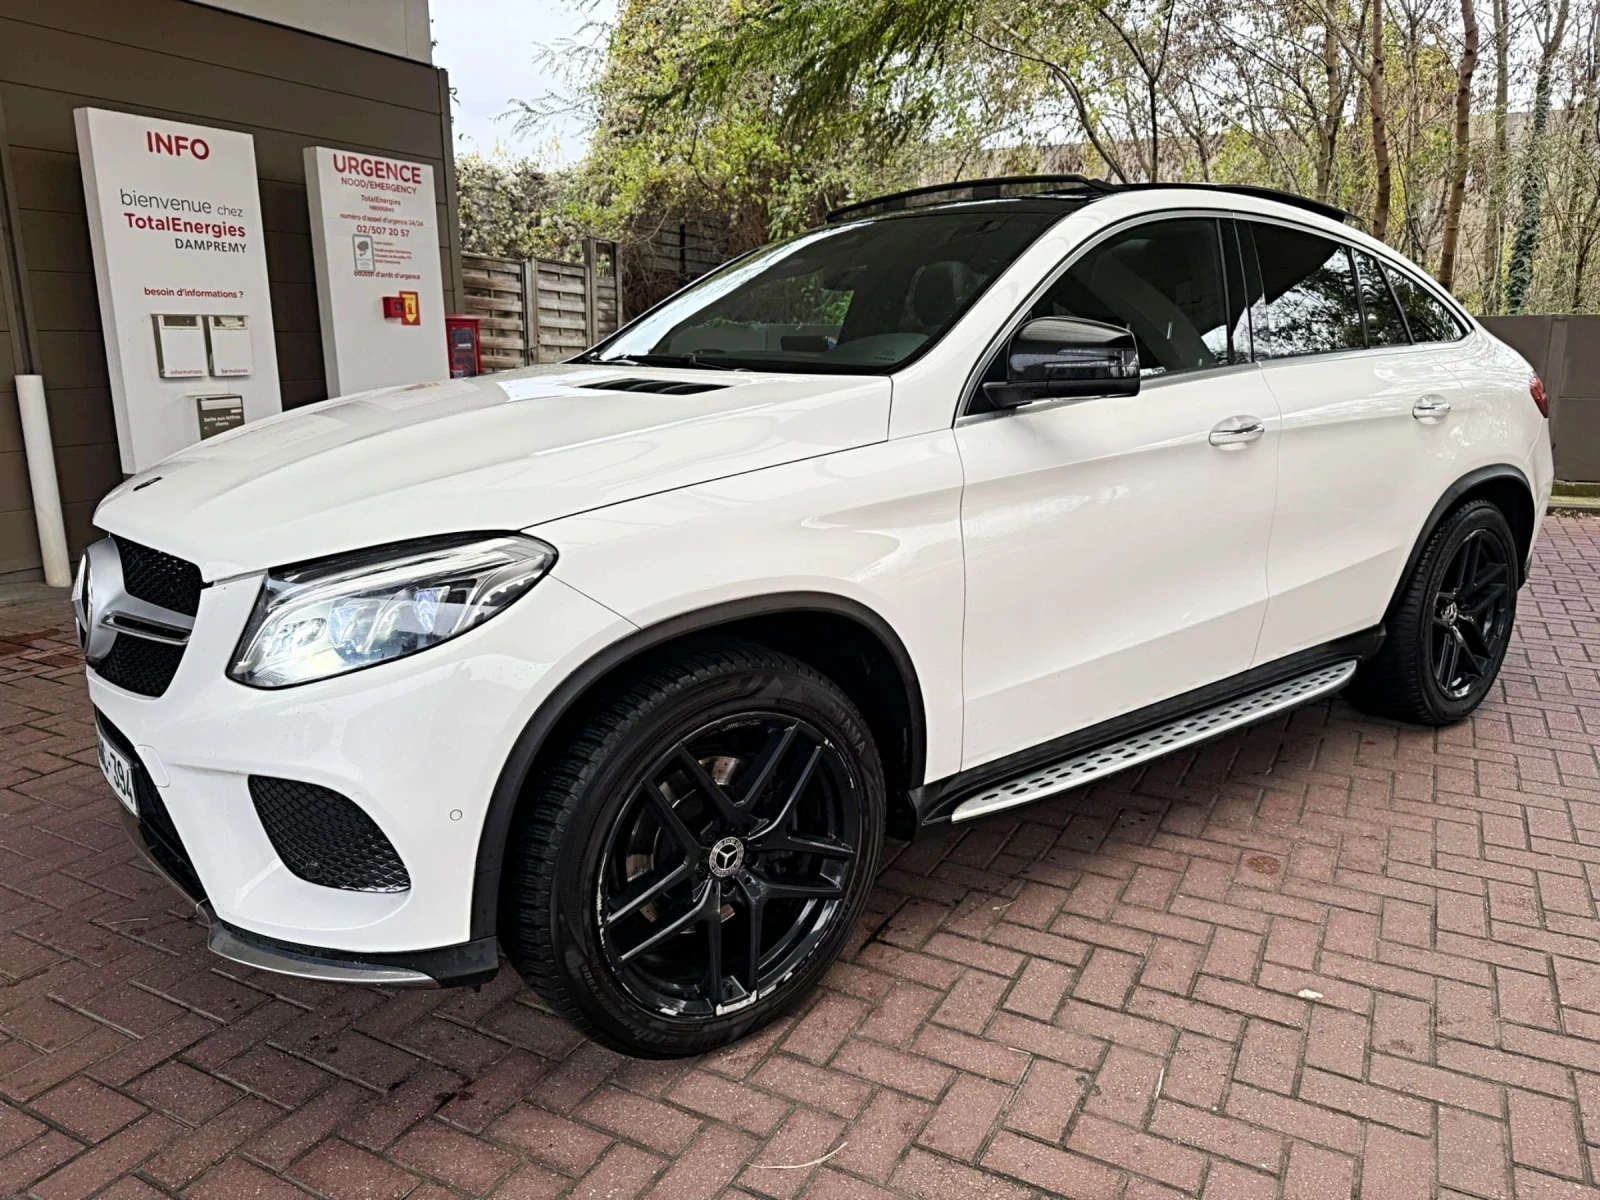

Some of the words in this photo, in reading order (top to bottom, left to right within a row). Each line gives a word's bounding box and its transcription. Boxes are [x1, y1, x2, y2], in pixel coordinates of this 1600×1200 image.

[146, 131, 210, 160] INFO
[333, 153, 422, 184] URGENCE
[341, 177, 417, 195] NOOD/EMERGENCY
[119, 188, 212, 214] bienvenue
[216, 204, 244, 218] chez
[360, 194, 401, 208] TotalEnergies
[123, 212, 246, 238] TotalEnergies
[339, 212, 361, 221] numéro
[362, 215, 382, 223] d'appel
[383, 217, 408, 226] d'urgence
[356, 224, 387, 235] 02/507
[388, 228, 399, 237] 20
[400, 229, 410, 238] 57
[175, 238, 247, 254] DAMPREMY
[394, 272, 421, 280] d'urgence
[144, 286, 175, 297] besoin
[176, 287, 238, 299] d'informations
[238, 290, 244, 299] ?
